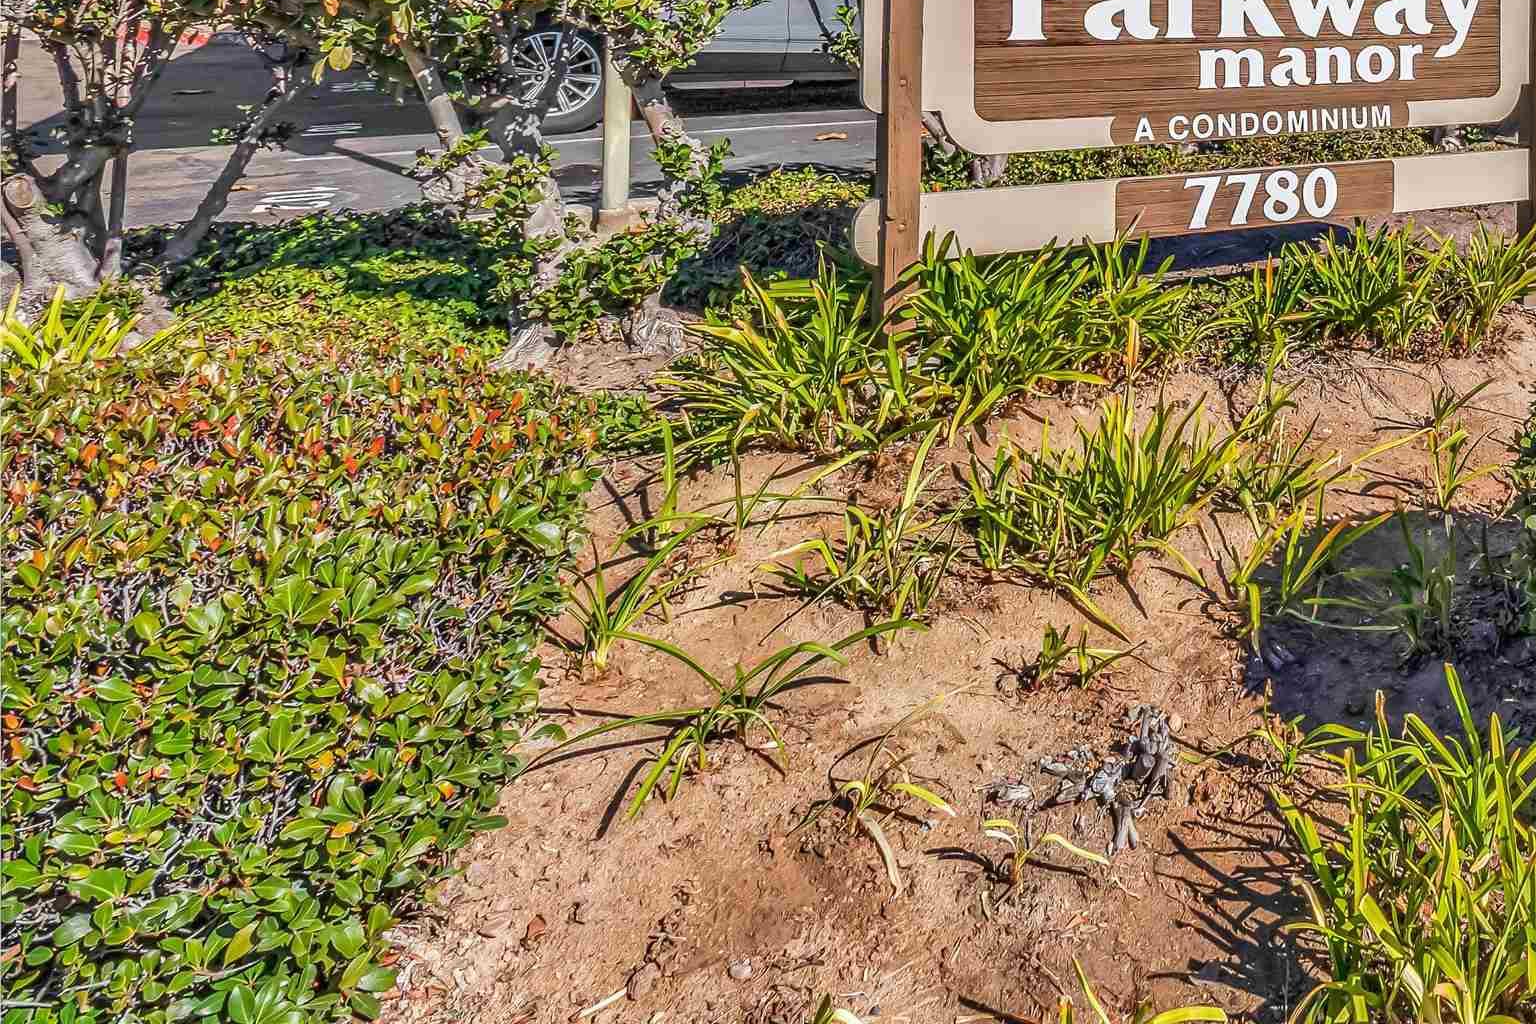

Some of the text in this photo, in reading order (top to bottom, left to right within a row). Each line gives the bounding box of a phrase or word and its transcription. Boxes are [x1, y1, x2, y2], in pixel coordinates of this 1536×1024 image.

[1198, 44, 1424, 90] manor
[1134, 104, 1392, 143] A CONDOMINIUM
[1183, 166, 1338, 230] 7780
